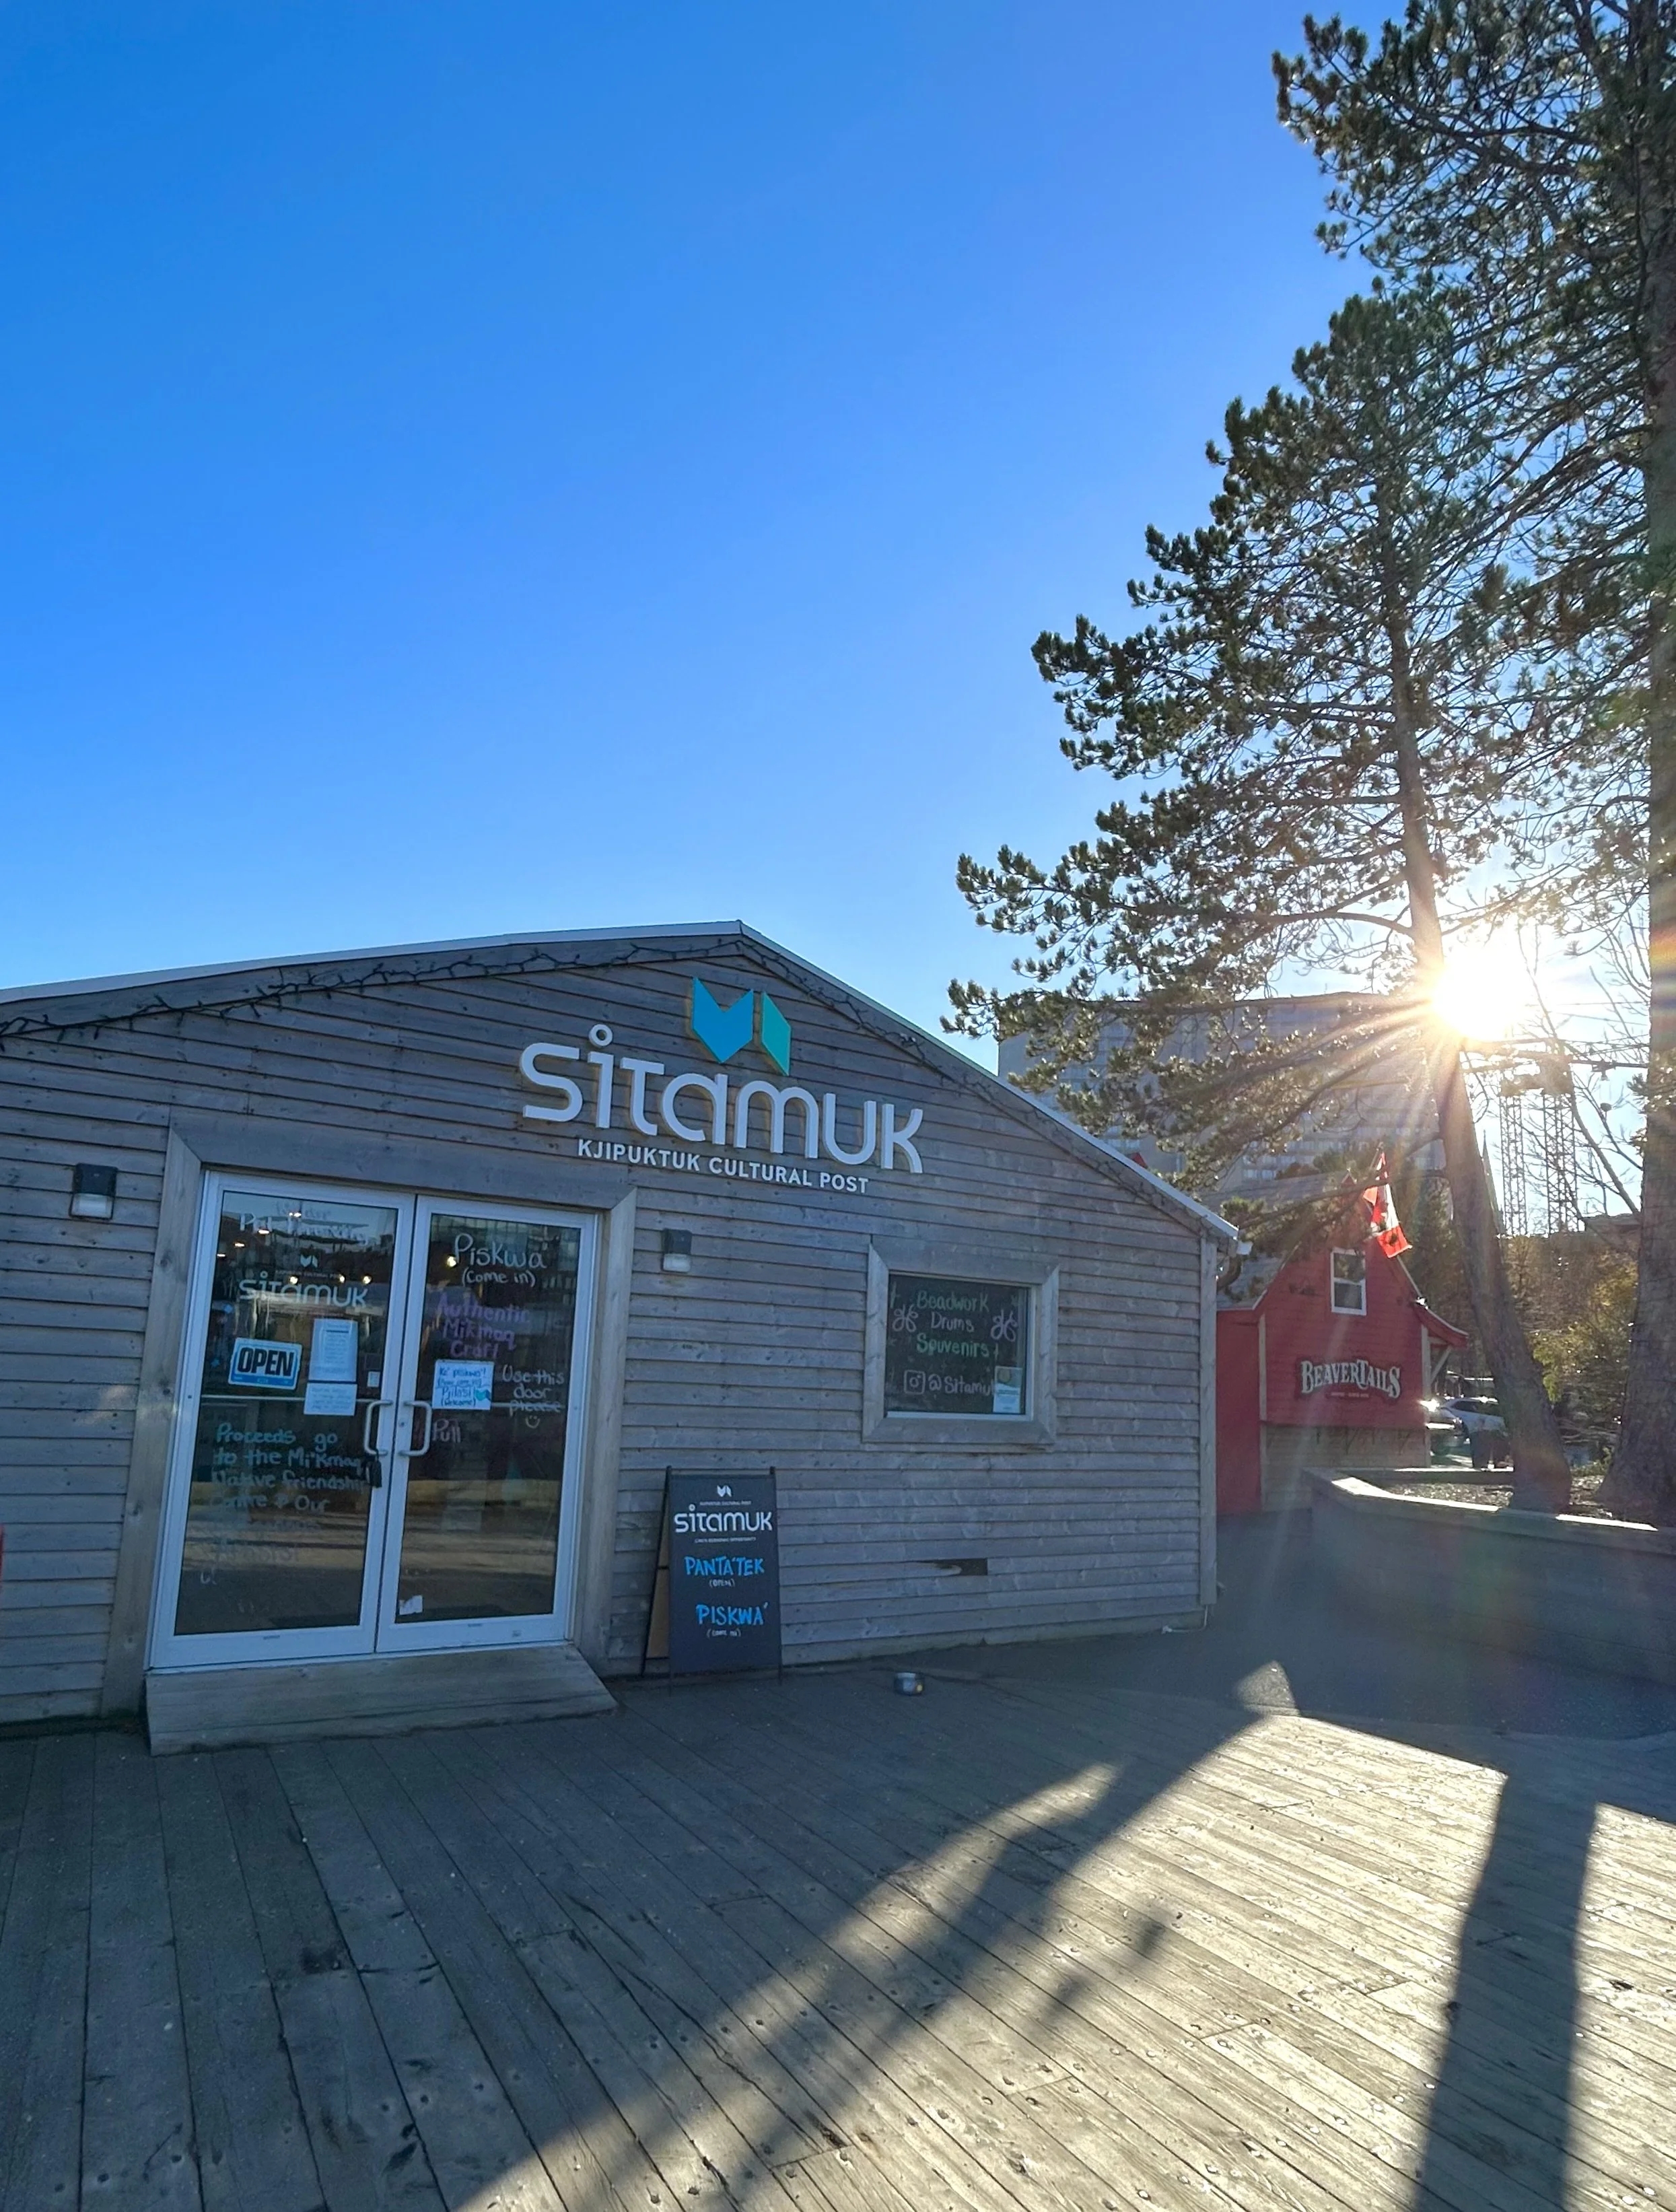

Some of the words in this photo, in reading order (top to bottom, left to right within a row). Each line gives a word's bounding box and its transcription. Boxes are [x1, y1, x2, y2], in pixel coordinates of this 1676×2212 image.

[578, 1138, 701, 1171] KJIPUKTUK
[709, 1156, 813, 1187] CULTURAL
[819, 1172, 869, 1194] POST
[931, 1312, 975, 1333] Drums
[916, 1333, 990, 1358] Souvenirs
[238, 1346, 295, 1377] OPEN
[502, 1364, 531, 1383] Use
[531, 1368, 565, 1385] this
[513, 1383, 553, 1399] door
[509, 1398, 561, 1417] please
[215, 1422, 296, 1445] Proceeds
[314, 1432, 338, 1452] go
[431, 1418, 462, 1443] Pull
[212, 1447, 236, 1465] to
[245, 1449, 281, 1466] the
[294, 1494, 330, 1512] Our
